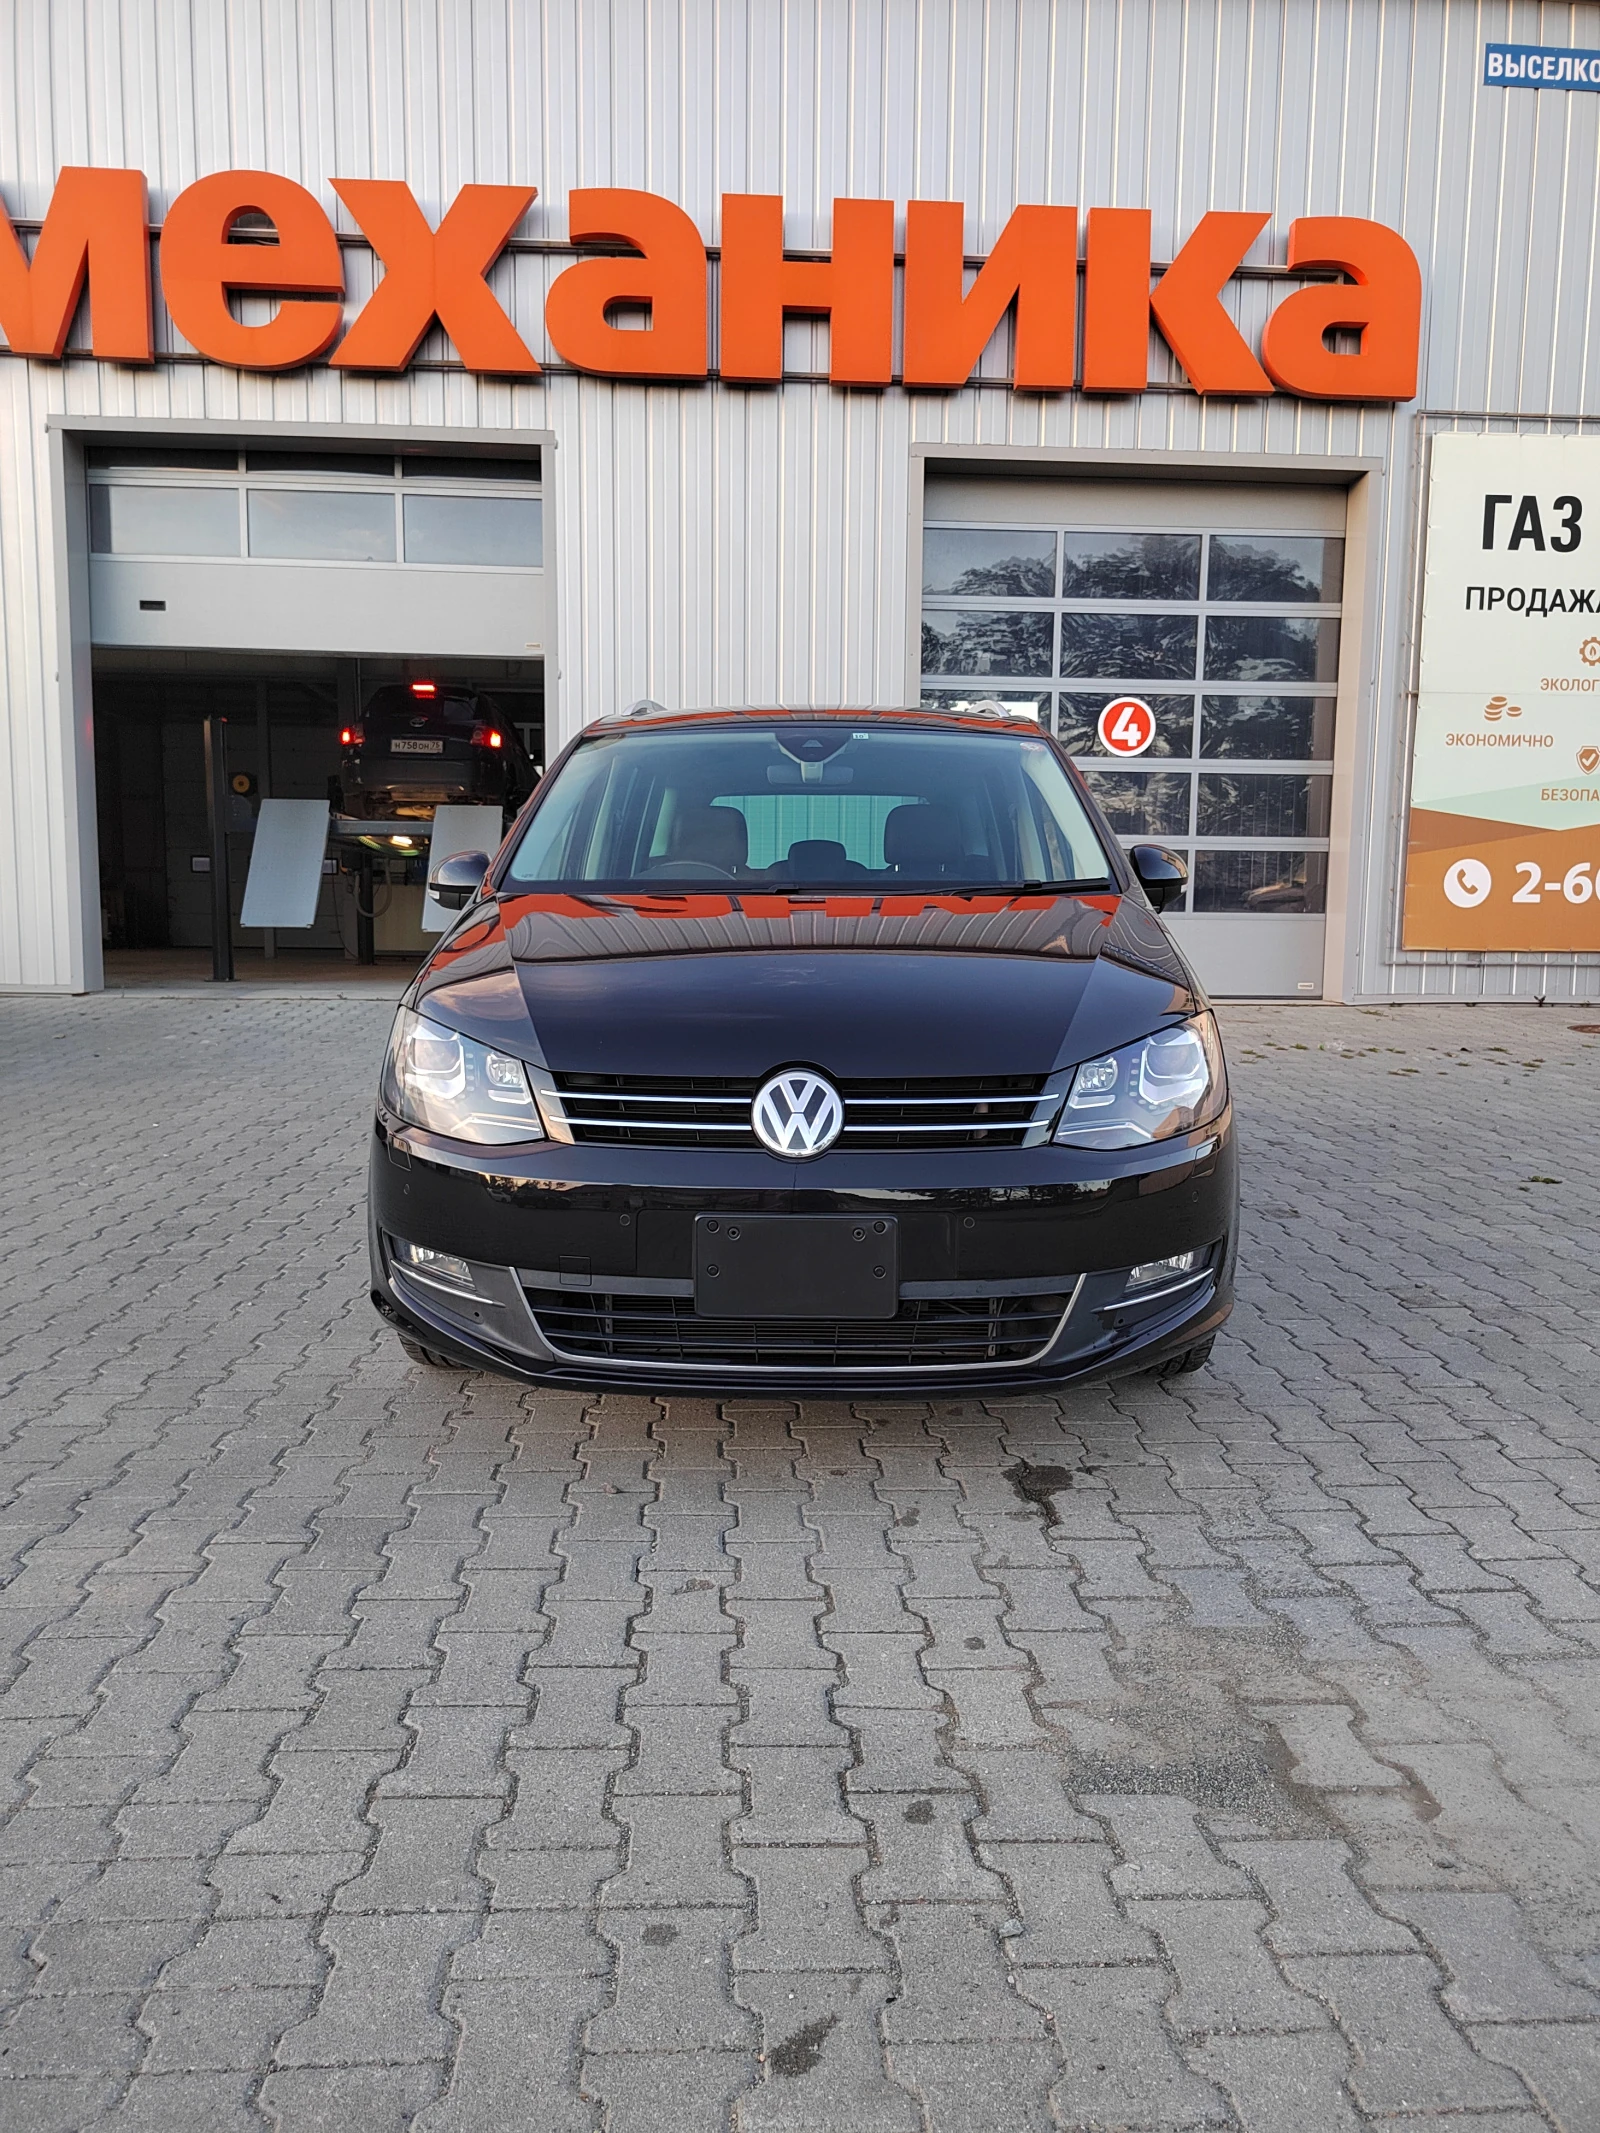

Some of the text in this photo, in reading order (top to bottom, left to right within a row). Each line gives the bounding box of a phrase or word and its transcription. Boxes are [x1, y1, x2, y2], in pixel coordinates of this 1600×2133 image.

[1487, 53, 1600, 83] ВЫСЕЛКО
[1482, 494, 1583, 553] ГАЗ
[1465, 586, 1600, 618] ПРОДАЖ
[1540, 677, 1600, 692] ЭКОЛОГ
[1111, 706, 1142, 747] 4
[1445, 733, 1554, 748] ЭКОНОМИЧНО
[1541, 788, 1600, 802] БЕЗОПА
[1512, 861, 1600, 904] 2-6
